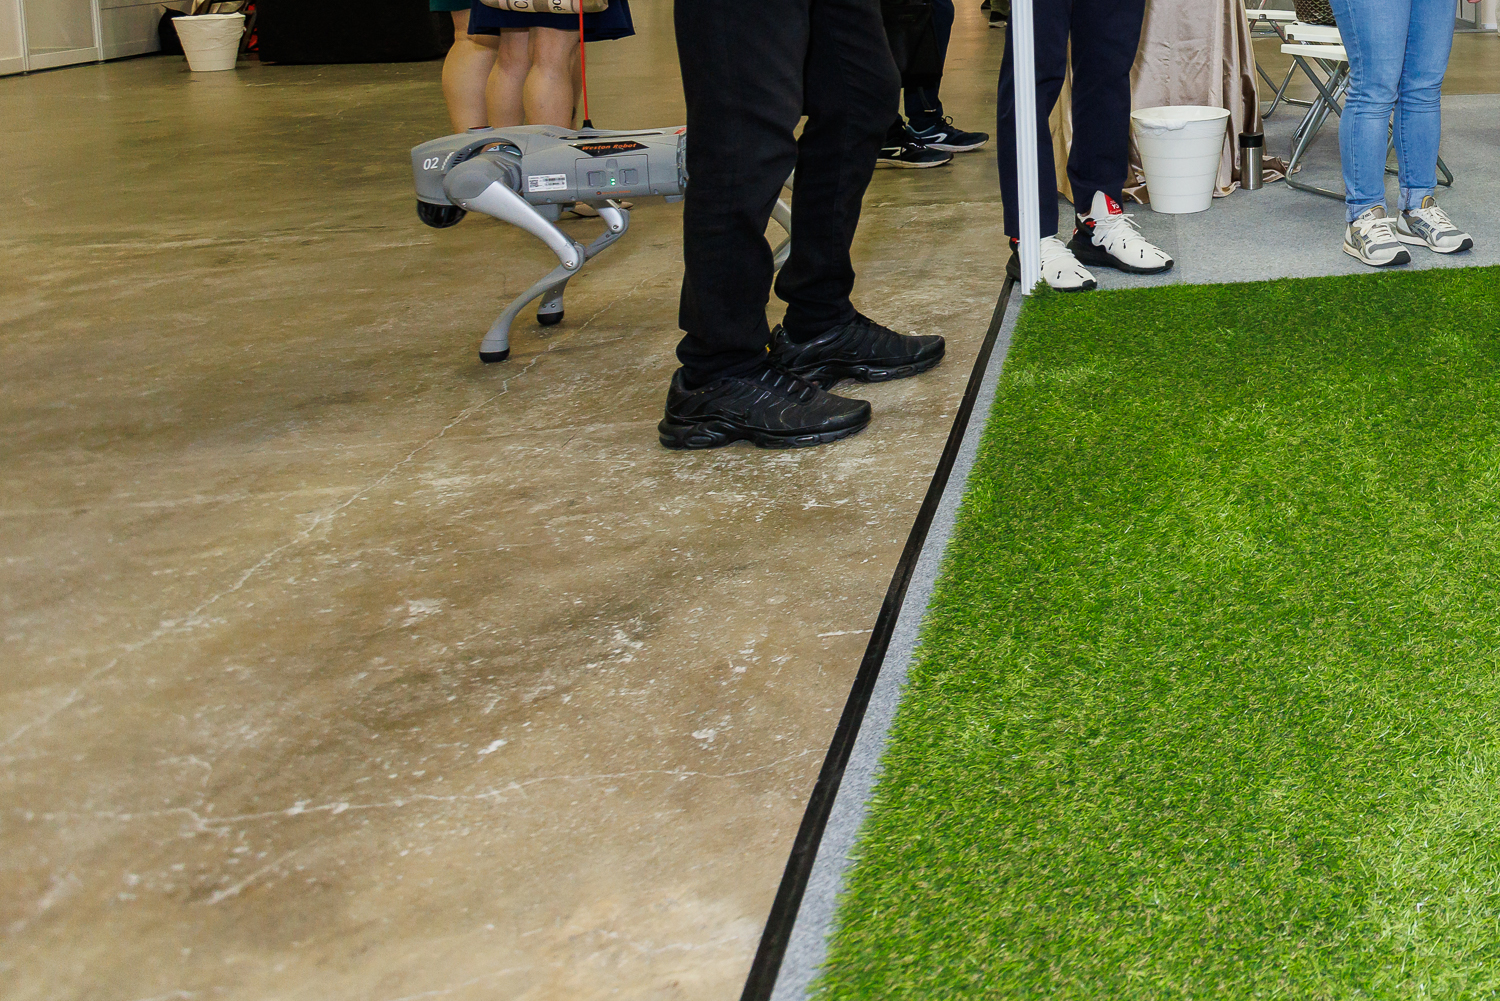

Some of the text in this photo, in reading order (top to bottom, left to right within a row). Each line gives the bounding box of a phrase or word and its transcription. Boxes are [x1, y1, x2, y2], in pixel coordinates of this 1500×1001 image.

[581, 142, 637, 151] Weston Robot
[423, 156, 439, 170] 02
